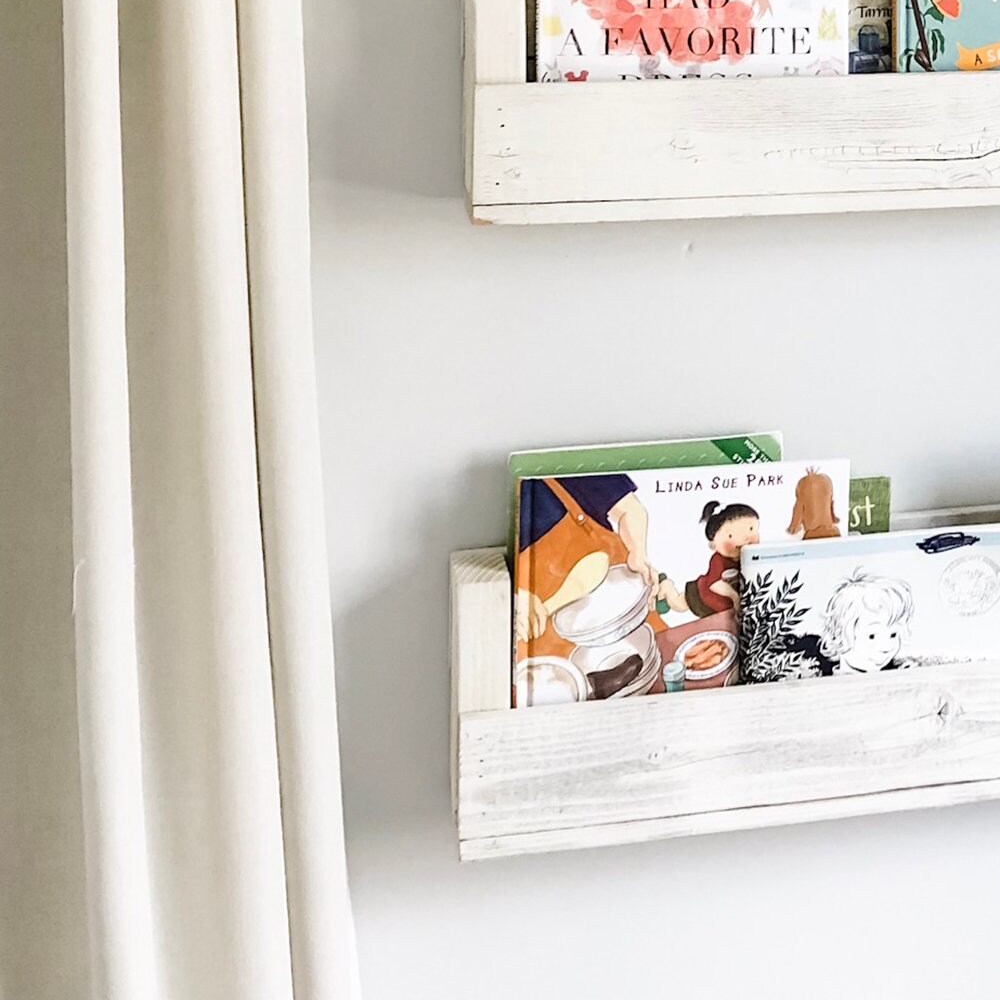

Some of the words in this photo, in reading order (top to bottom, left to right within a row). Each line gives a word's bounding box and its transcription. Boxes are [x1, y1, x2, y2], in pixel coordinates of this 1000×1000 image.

[557, 28, 584, 56] A
[600, 26, 812, 56] FAVORITE
[973, 54, 983, 67] A
[655, 473, 703, 494] LINDA
[711, 475, 738, 491] SUE
[746, 472, 784, 489] PARK
